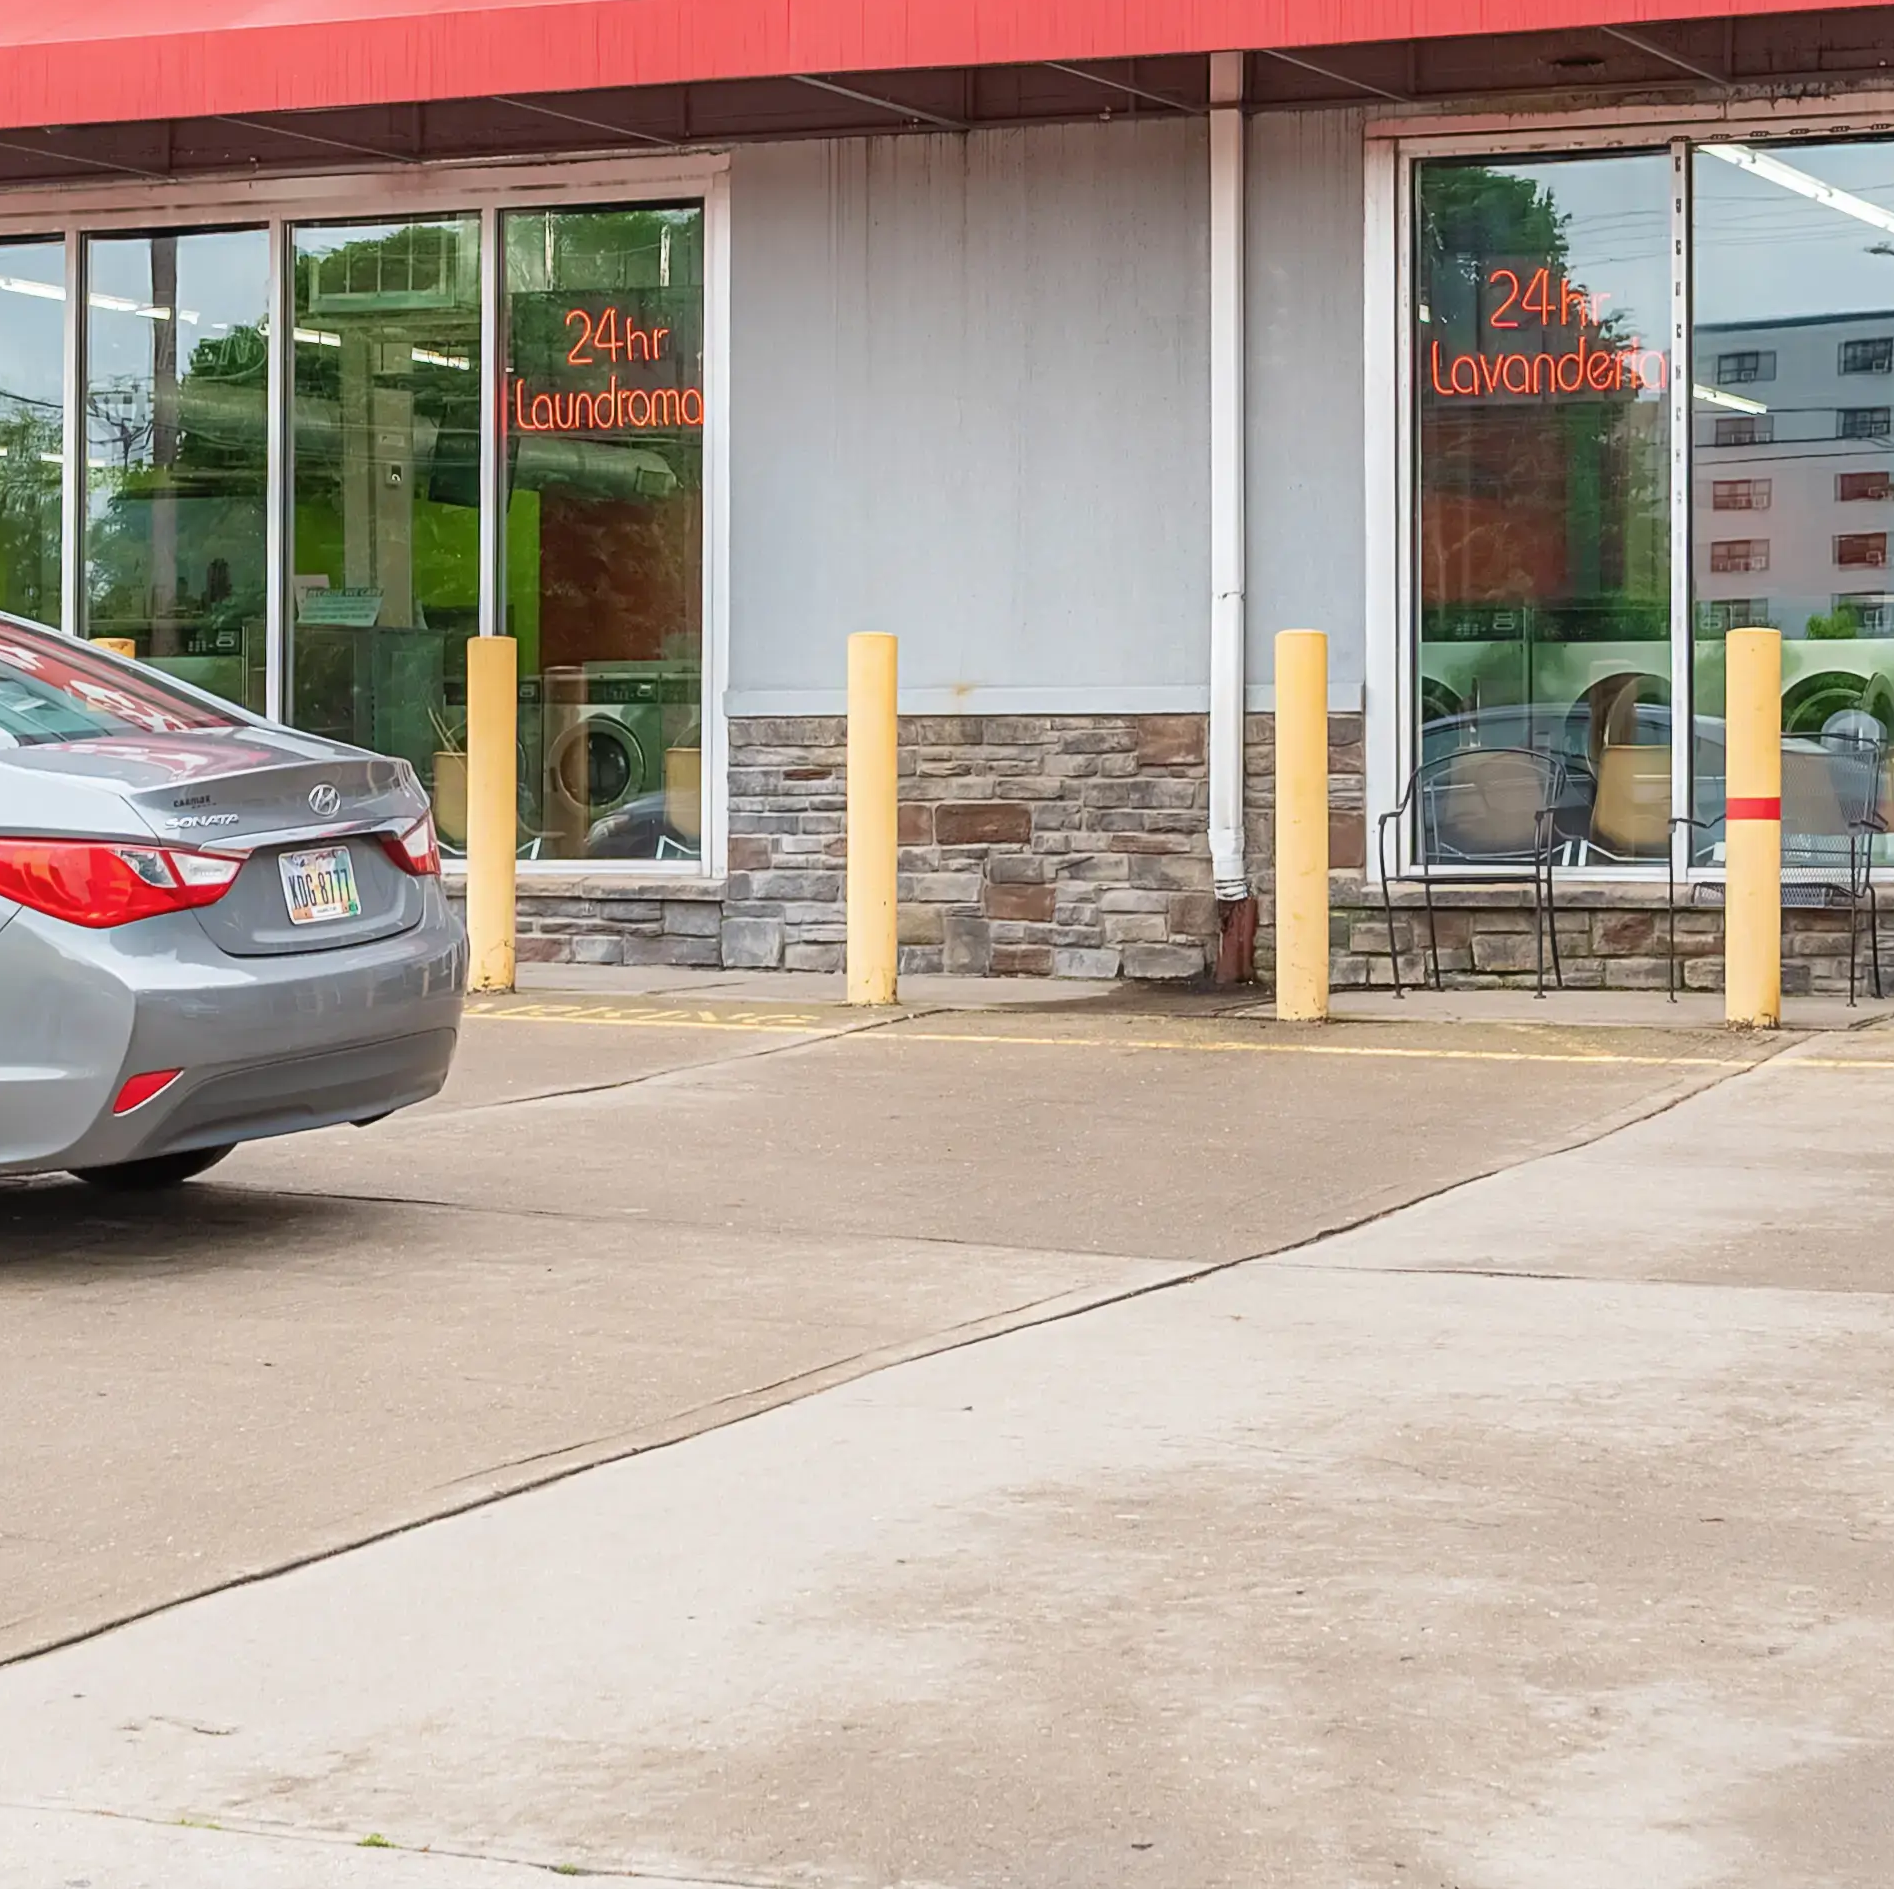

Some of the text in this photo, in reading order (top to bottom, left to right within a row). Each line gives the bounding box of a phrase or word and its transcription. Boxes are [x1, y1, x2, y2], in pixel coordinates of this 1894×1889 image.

[1489, 267, 1612, 328] 24hr
[565, 306, 670, 365] 24hr
[1431, 335, 1667, 398] Lavanderia
[516, 374, 705, 430] Laundroma
[165, 813, 240, 830] SONATA
[318, 868, 350, 904] 8777
